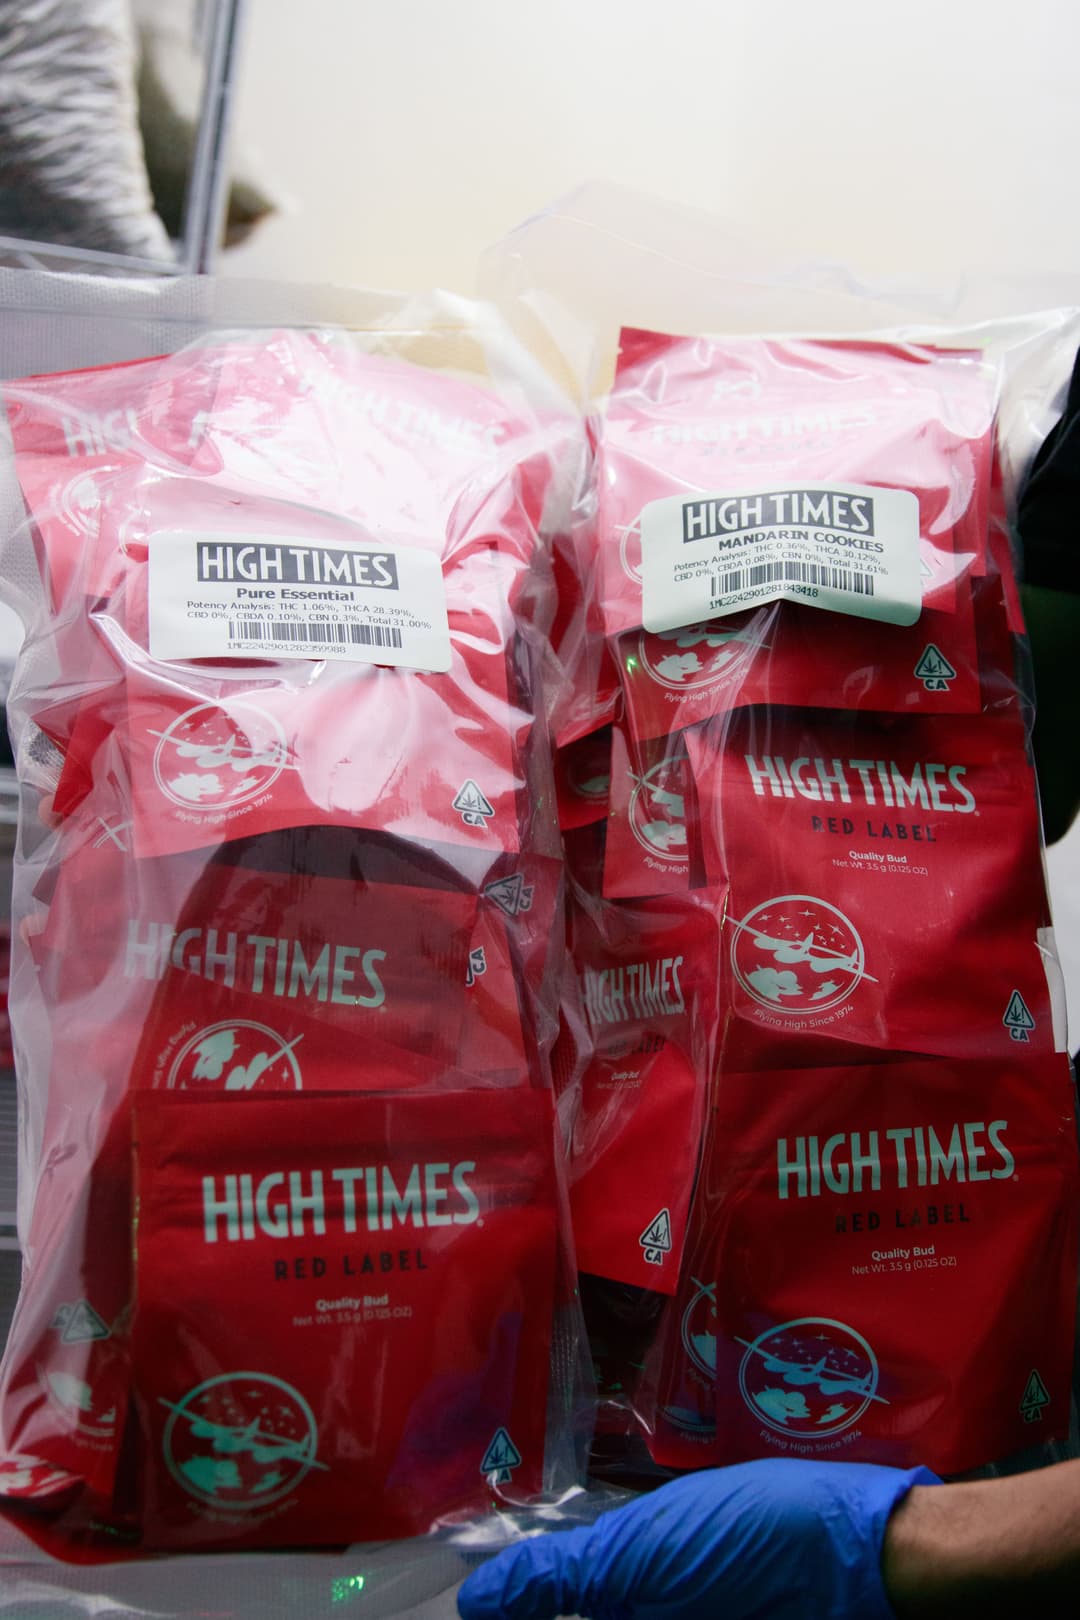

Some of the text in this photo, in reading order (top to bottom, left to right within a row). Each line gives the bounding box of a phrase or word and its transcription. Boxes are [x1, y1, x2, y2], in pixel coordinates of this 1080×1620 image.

[687, 492, 869, 539] HIGH TIMES
[719, 530, 884, 553] MANDARIN COOKIES
[202, 546, 393, 586] HIGH TIMES
[674, 559, 709, 572] Potency
[711, 549, 751, 564] Analysis:
[754, 542, 774, 553] THC
[815, 544, 840, 556] THCA
[674, 571, 693, 582] CBD
[717, 560, 743, 572] CBDA
[781, 551, 802, 559] CBN
[828, 556, 850, 568] Total
[853, 562, 889, 575] 31.61%
[237, 588, 354, 601] Pure Essential
[187, 601, 227, 611] Potency
[230, 602, 275, 612] Analysis:
[280, 603, 298, 611] THC
[303, 604, 339, 612] 1.06%,
[344, 604, 370, 613] THCA
[187, 611, 209, 619] CBD
[236, 612, 264, 620] CBDA
[309, 613, 330, 621] CBN
[367, 616, 391, 625] Total
[393, 618, 432, 629] 31.00%
[925, 679, 947, 690] CA
[664, 692, 688, 703] Flying
[744, 755, 976, 813] HIGH TIMES
[463, 812, 486, 827] CA
[811, 815, 936, 842] RED LABEL
[832, 859, 849, 867] Net
[880, 865, 887, 873] g
[912, 866, 928, 876] OZ)
[849, 850, 907, 863] Quality Bud
[519, 887, 533, 909] CA
[124, 920, 387, 1008] HIGH TIMES
[472, 948, 485, 974] CA
[627, 955, 685, 1019] TIMES
[753, 1004, 854, 1031] Flying High Since 1974
[1012, 1028, 1028, 1041] CA
[777, 1120, 1015, 1199] HIGH TIMES
[202, 1161, 479, 1243] HIGH TIMES
[835, 1203, 970, 1233] RED LABEL
[274, 1249, 427, 1280] RED LABEL
[646, 1248, 662, 1264] CA
[871, 1244, 935, 1261] Quality Bud
[851, 1266, 869, 1275] Net
[889, 1262, 903, 1271] 3.5
[904, 1263, 911, 1271] g
[913, 1258, 938, 1270] (0.125
[939, 1256, 957, 1266] OZ)
